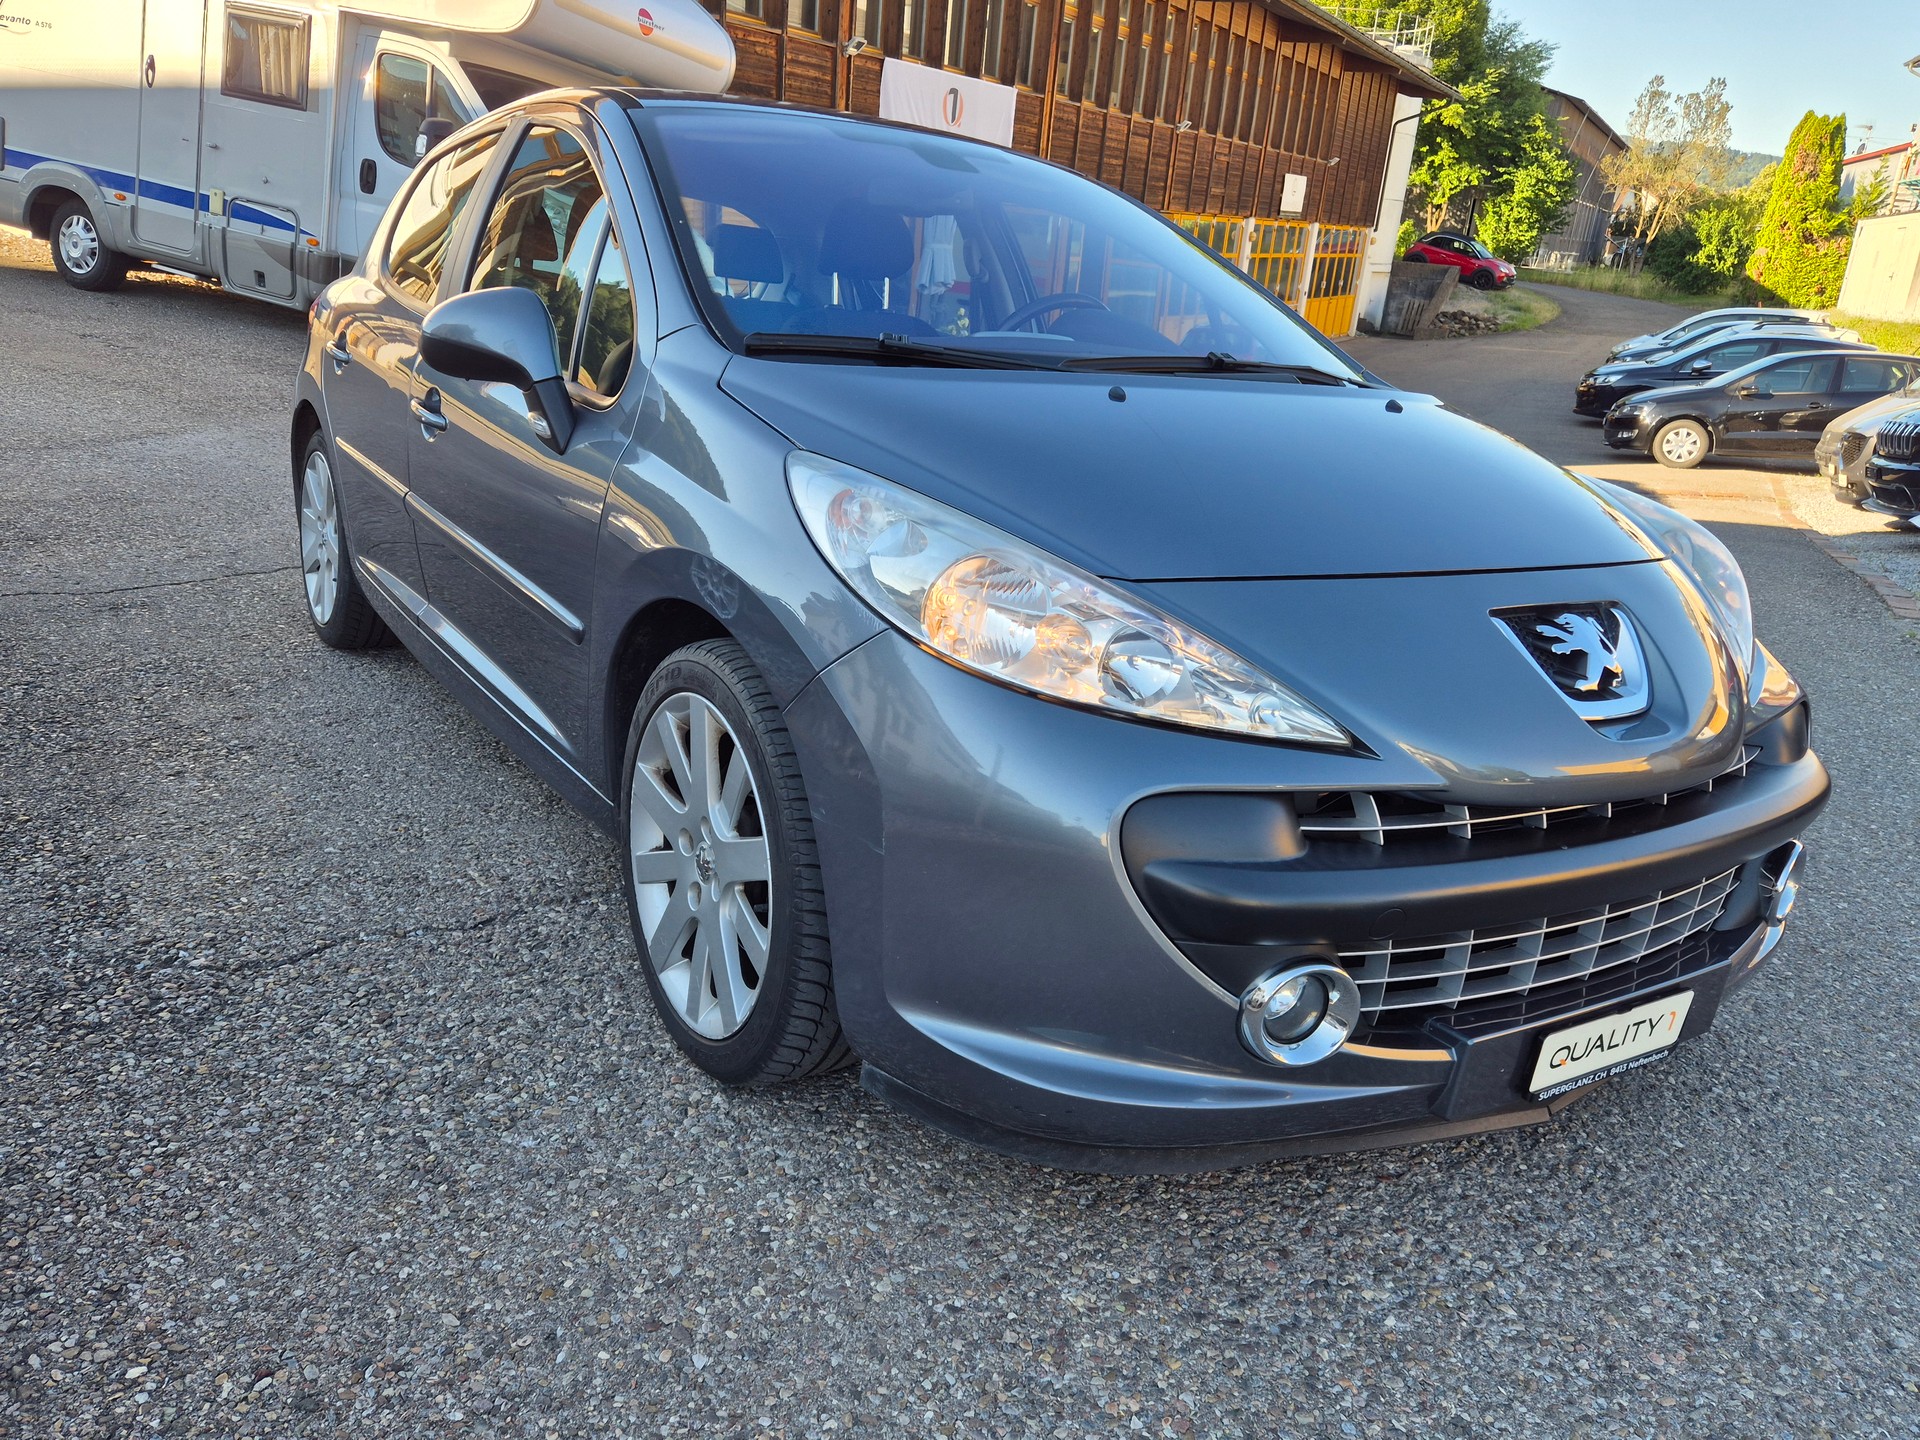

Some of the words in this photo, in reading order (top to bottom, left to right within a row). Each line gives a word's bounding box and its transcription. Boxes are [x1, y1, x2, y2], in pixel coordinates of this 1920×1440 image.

[0, 13, 31, 26] evanto
[1538, 1071, 1607, 1101] SUPERGLANZ.CH
[1609, 1062, 1628, 1076] 8413
[1628, 1049, 1669, 1071] Neftenbach
